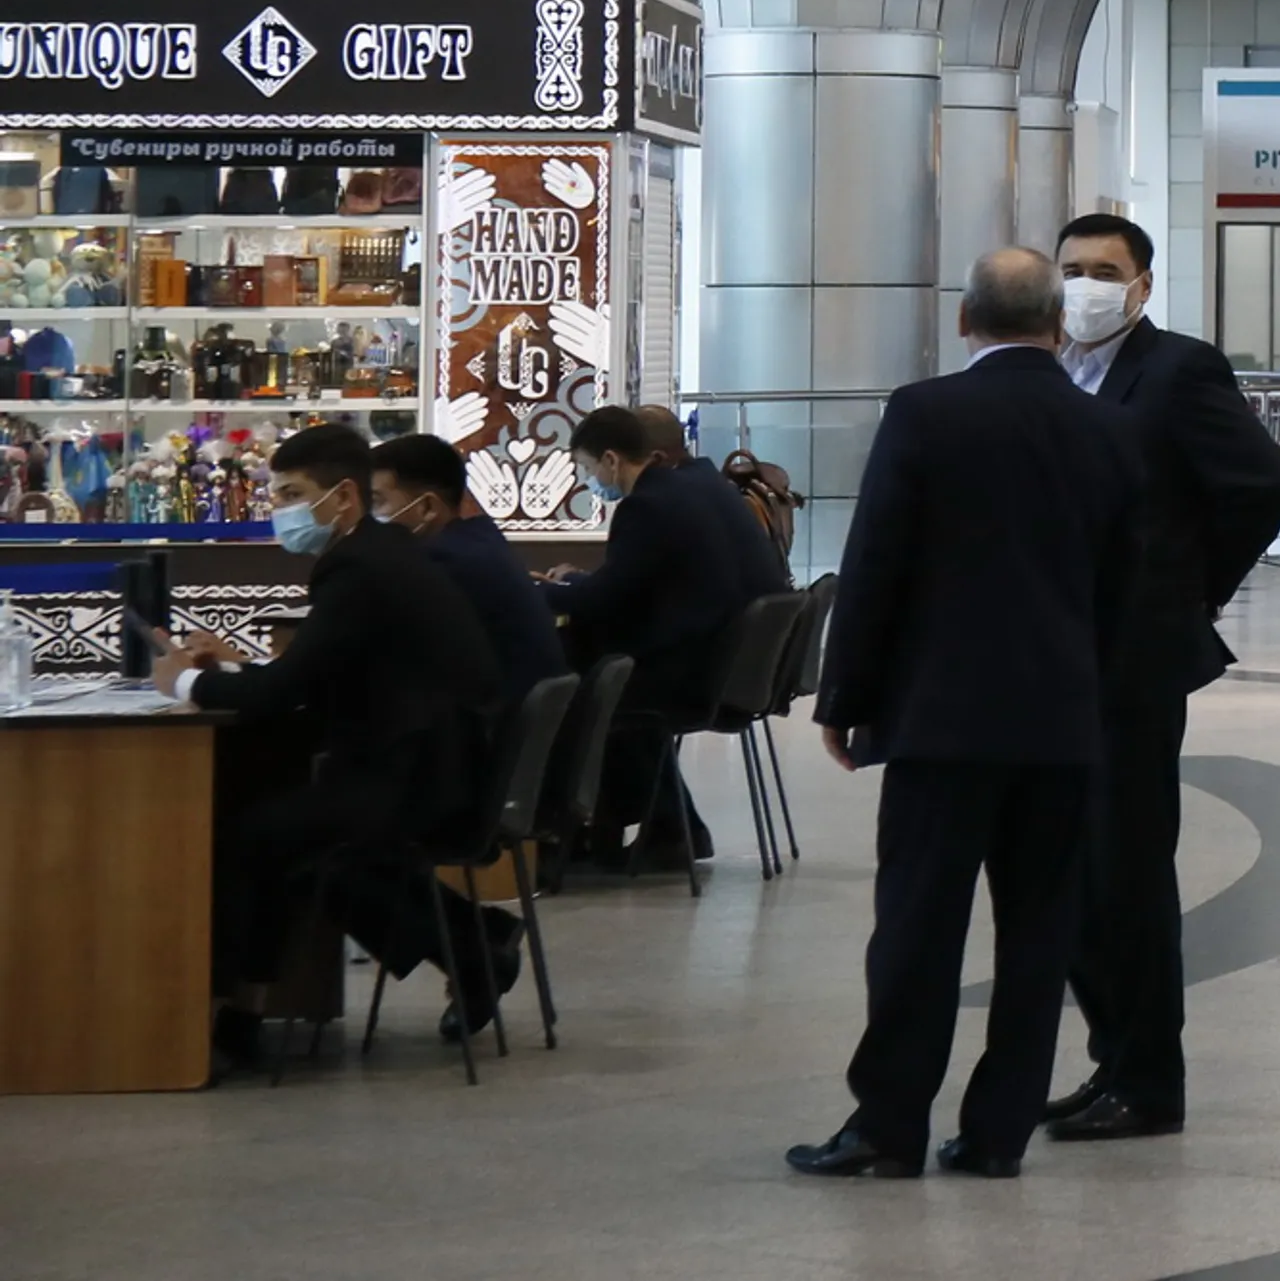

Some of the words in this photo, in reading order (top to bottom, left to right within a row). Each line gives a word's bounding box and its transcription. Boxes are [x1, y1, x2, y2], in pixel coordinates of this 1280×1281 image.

[341, 23, 473, 81] GIFT
[71, 138, 200, 160] Сувениры
[204, 137, 293, 160] ручной
[297, 137, 396, 160] работы
[472, 208, 580, 257] HAND
[468, 256, 582, 304] MADE
